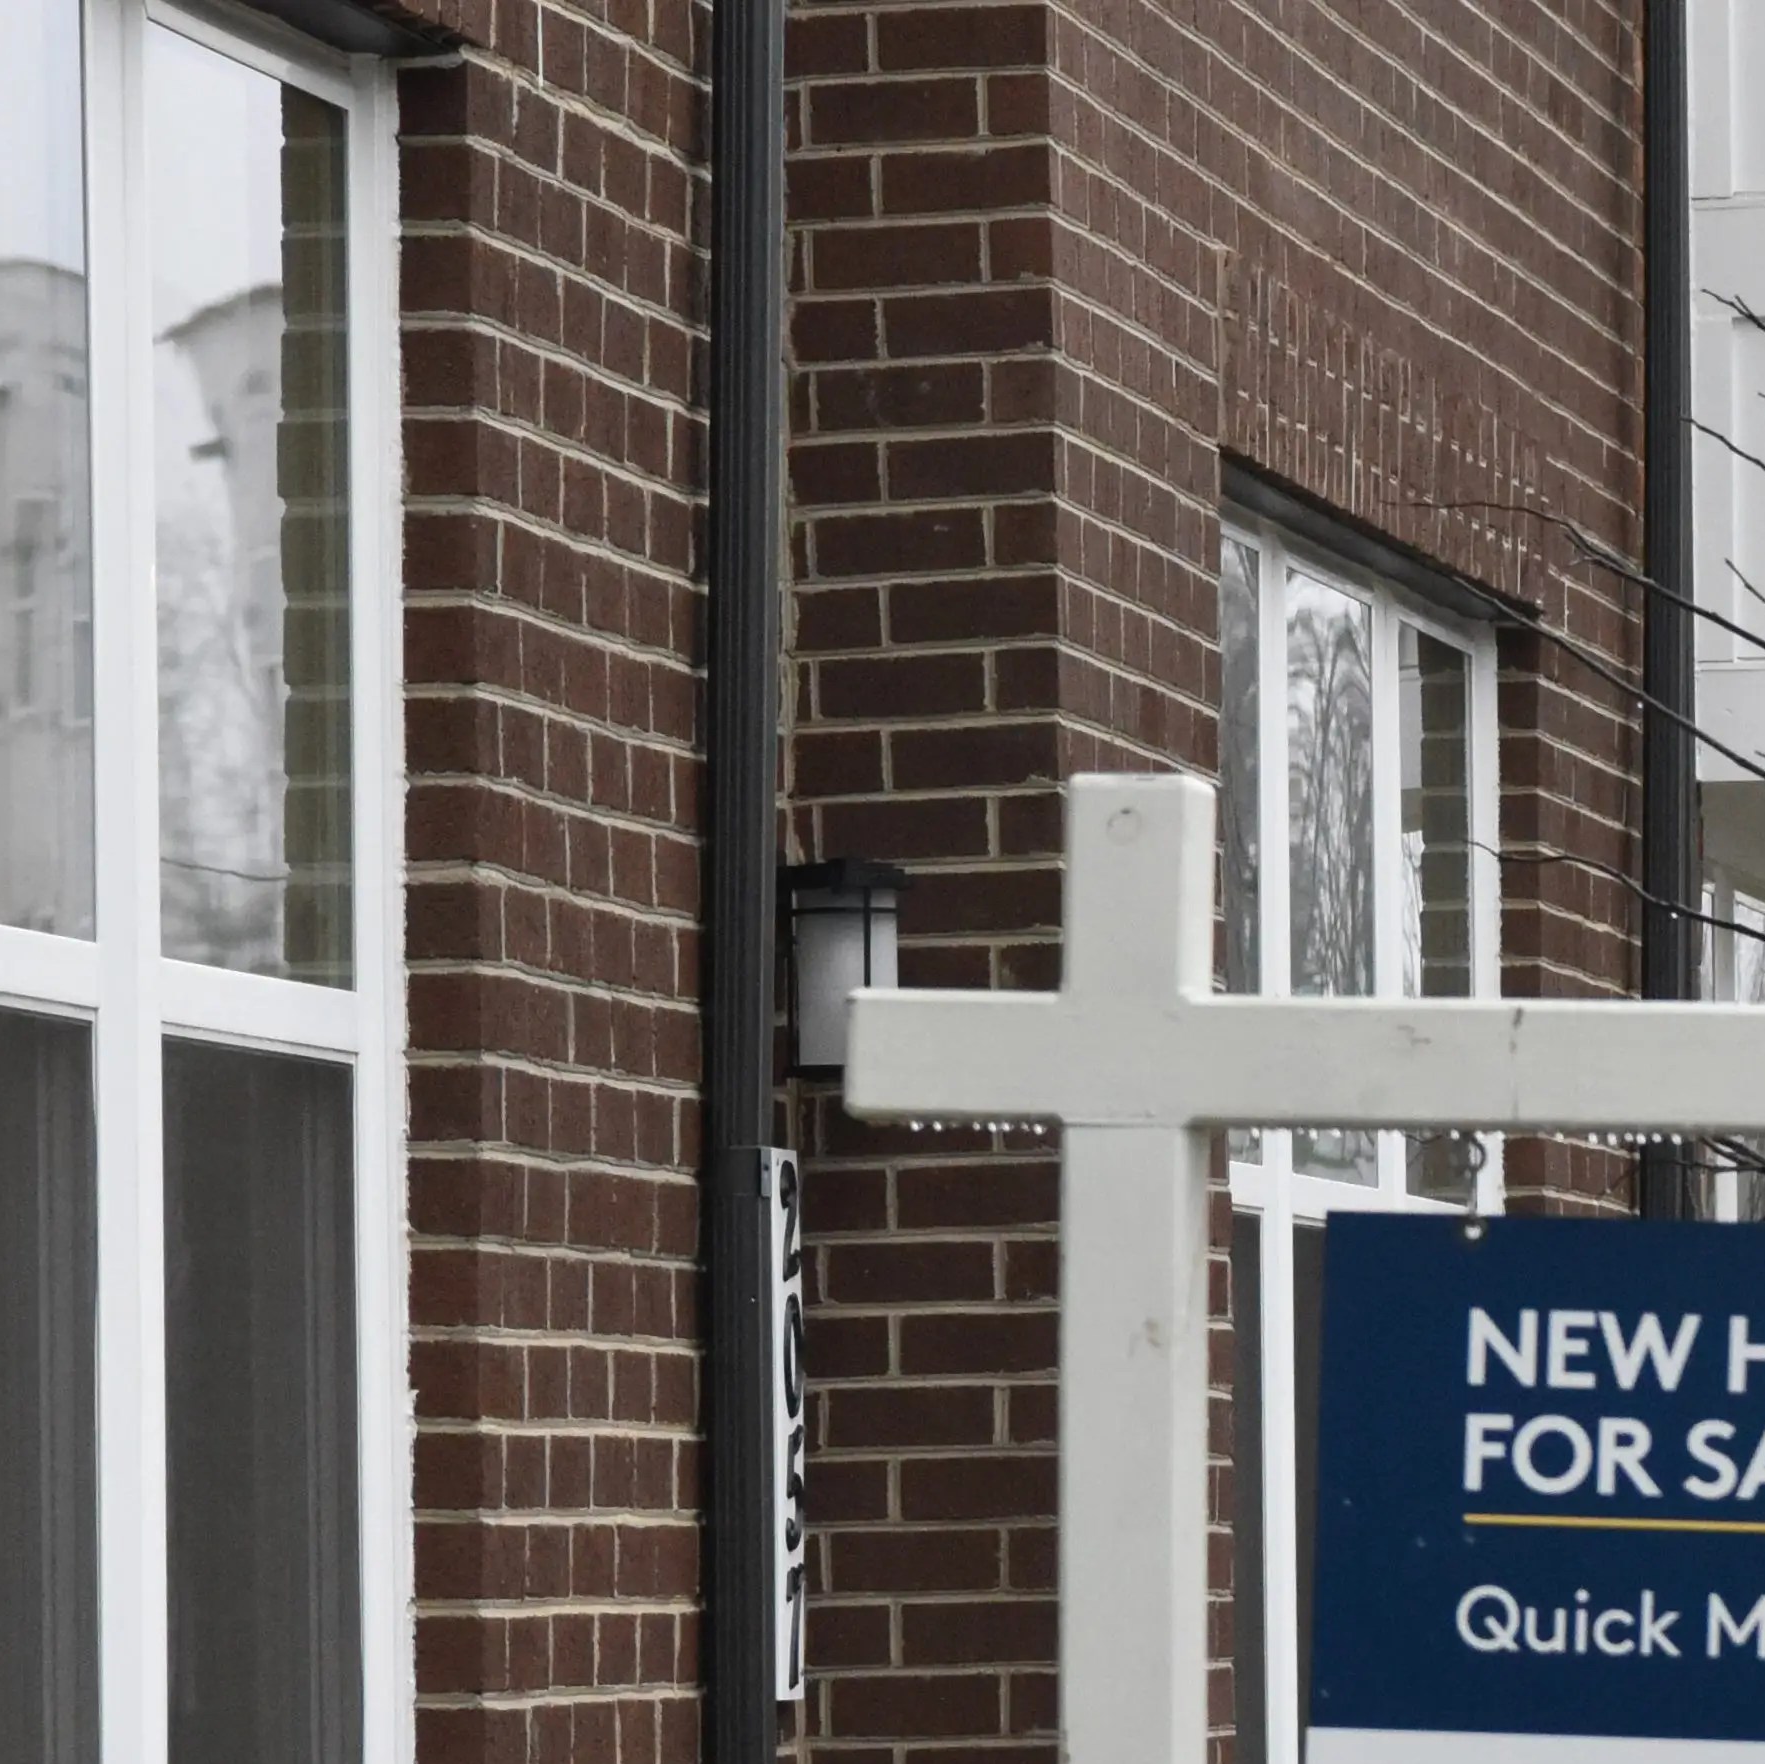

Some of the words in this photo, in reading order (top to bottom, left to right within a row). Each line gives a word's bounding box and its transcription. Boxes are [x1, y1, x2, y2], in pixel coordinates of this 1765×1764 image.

[1466, 1306, 1702, 1392] NEW
[779, 1159, 807, 1691] 2057
[1463, 1412, 1662, 1498] FOR
[1455, 1583, 1682, 1658] Quick
